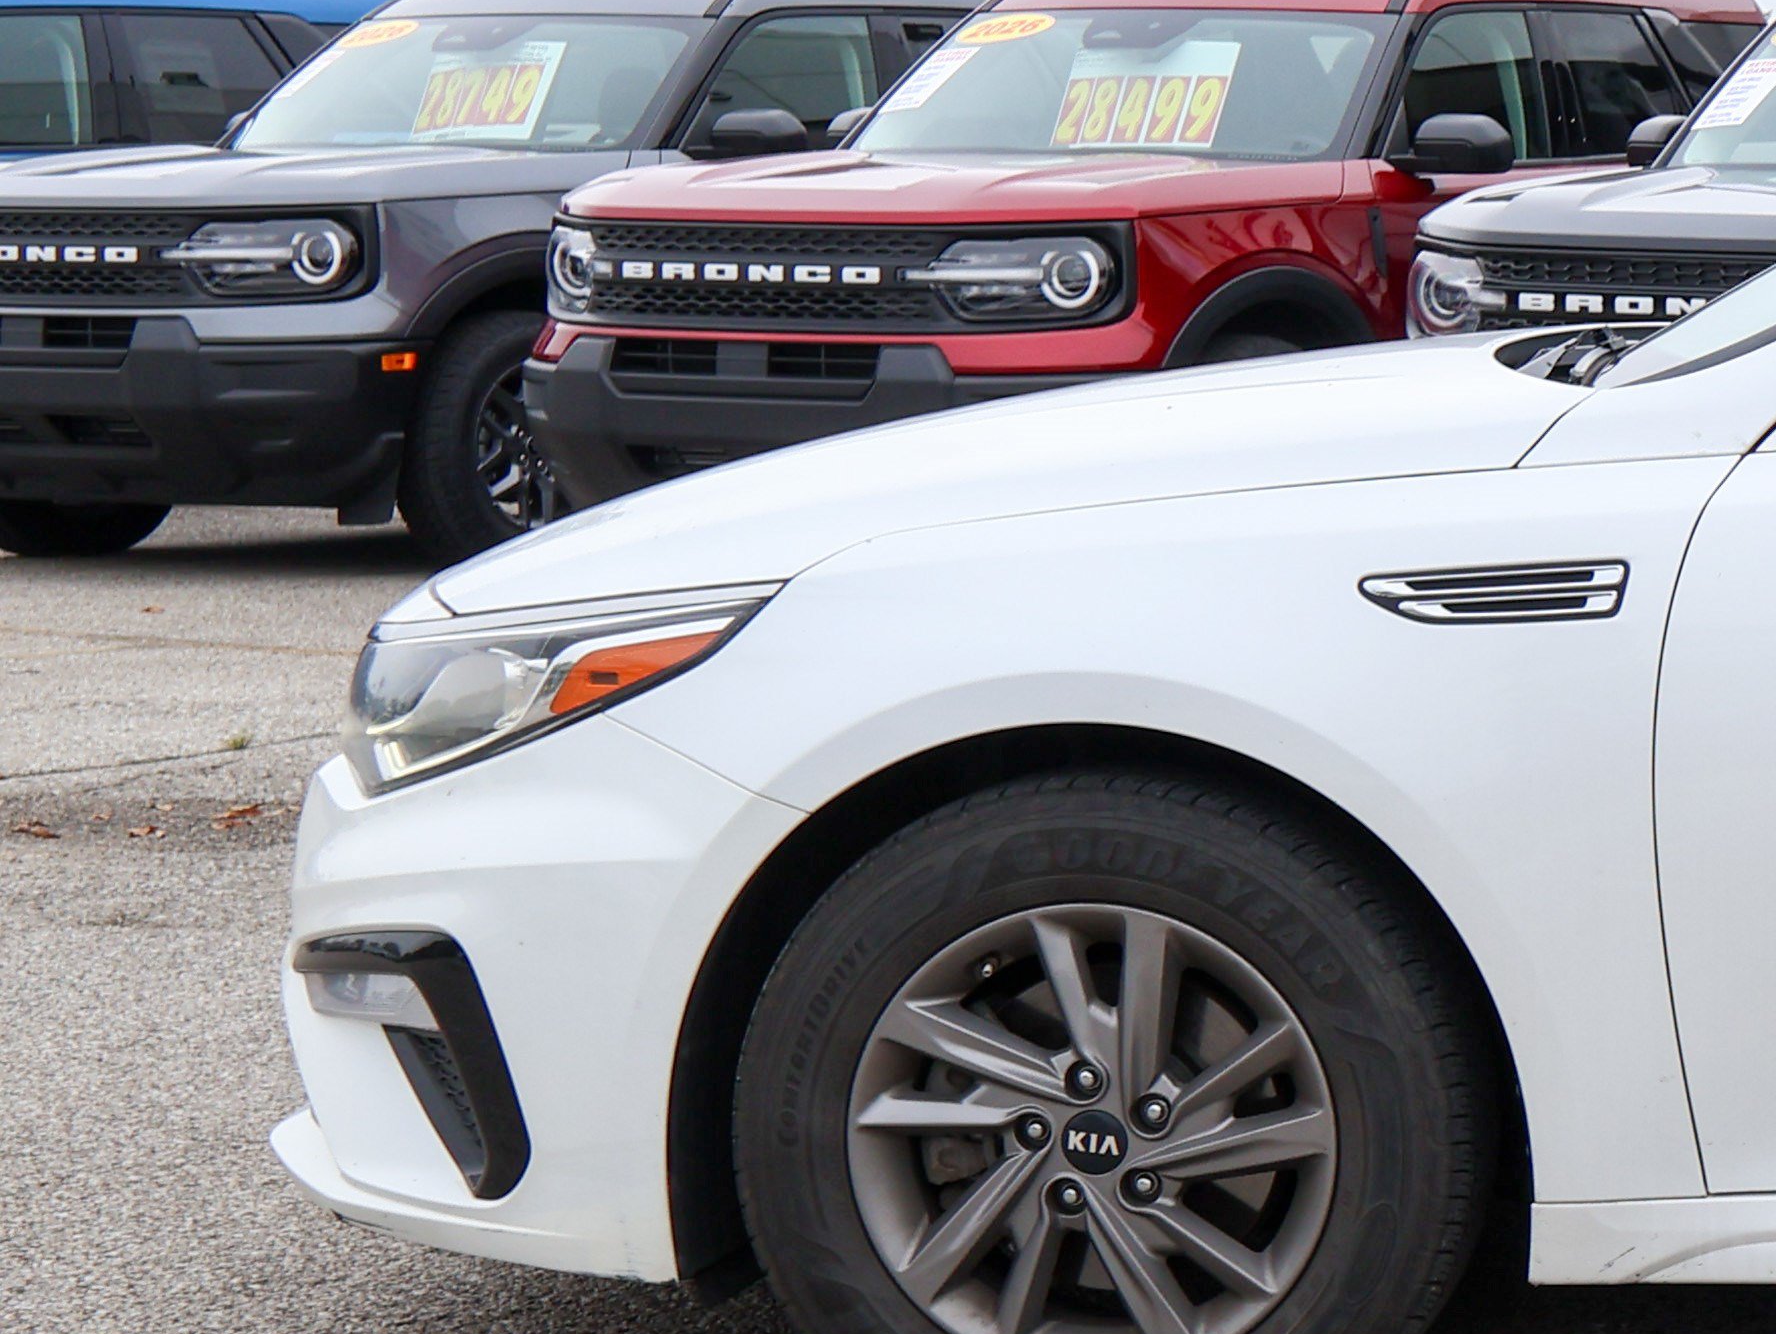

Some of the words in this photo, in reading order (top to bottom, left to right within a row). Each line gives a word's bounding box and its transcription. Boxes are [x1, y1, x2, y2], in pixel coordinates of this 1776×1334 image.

[963, 18, 1046, 40] 2026
[416, 67, 541, 132] 28749
[1054, 77, 1221, 142] 28499
[621, 260, 882, 285] BRONCO
[1517, 292, 1708, 316] BRON
[1067, 1129, 1120, 1156] KIA
